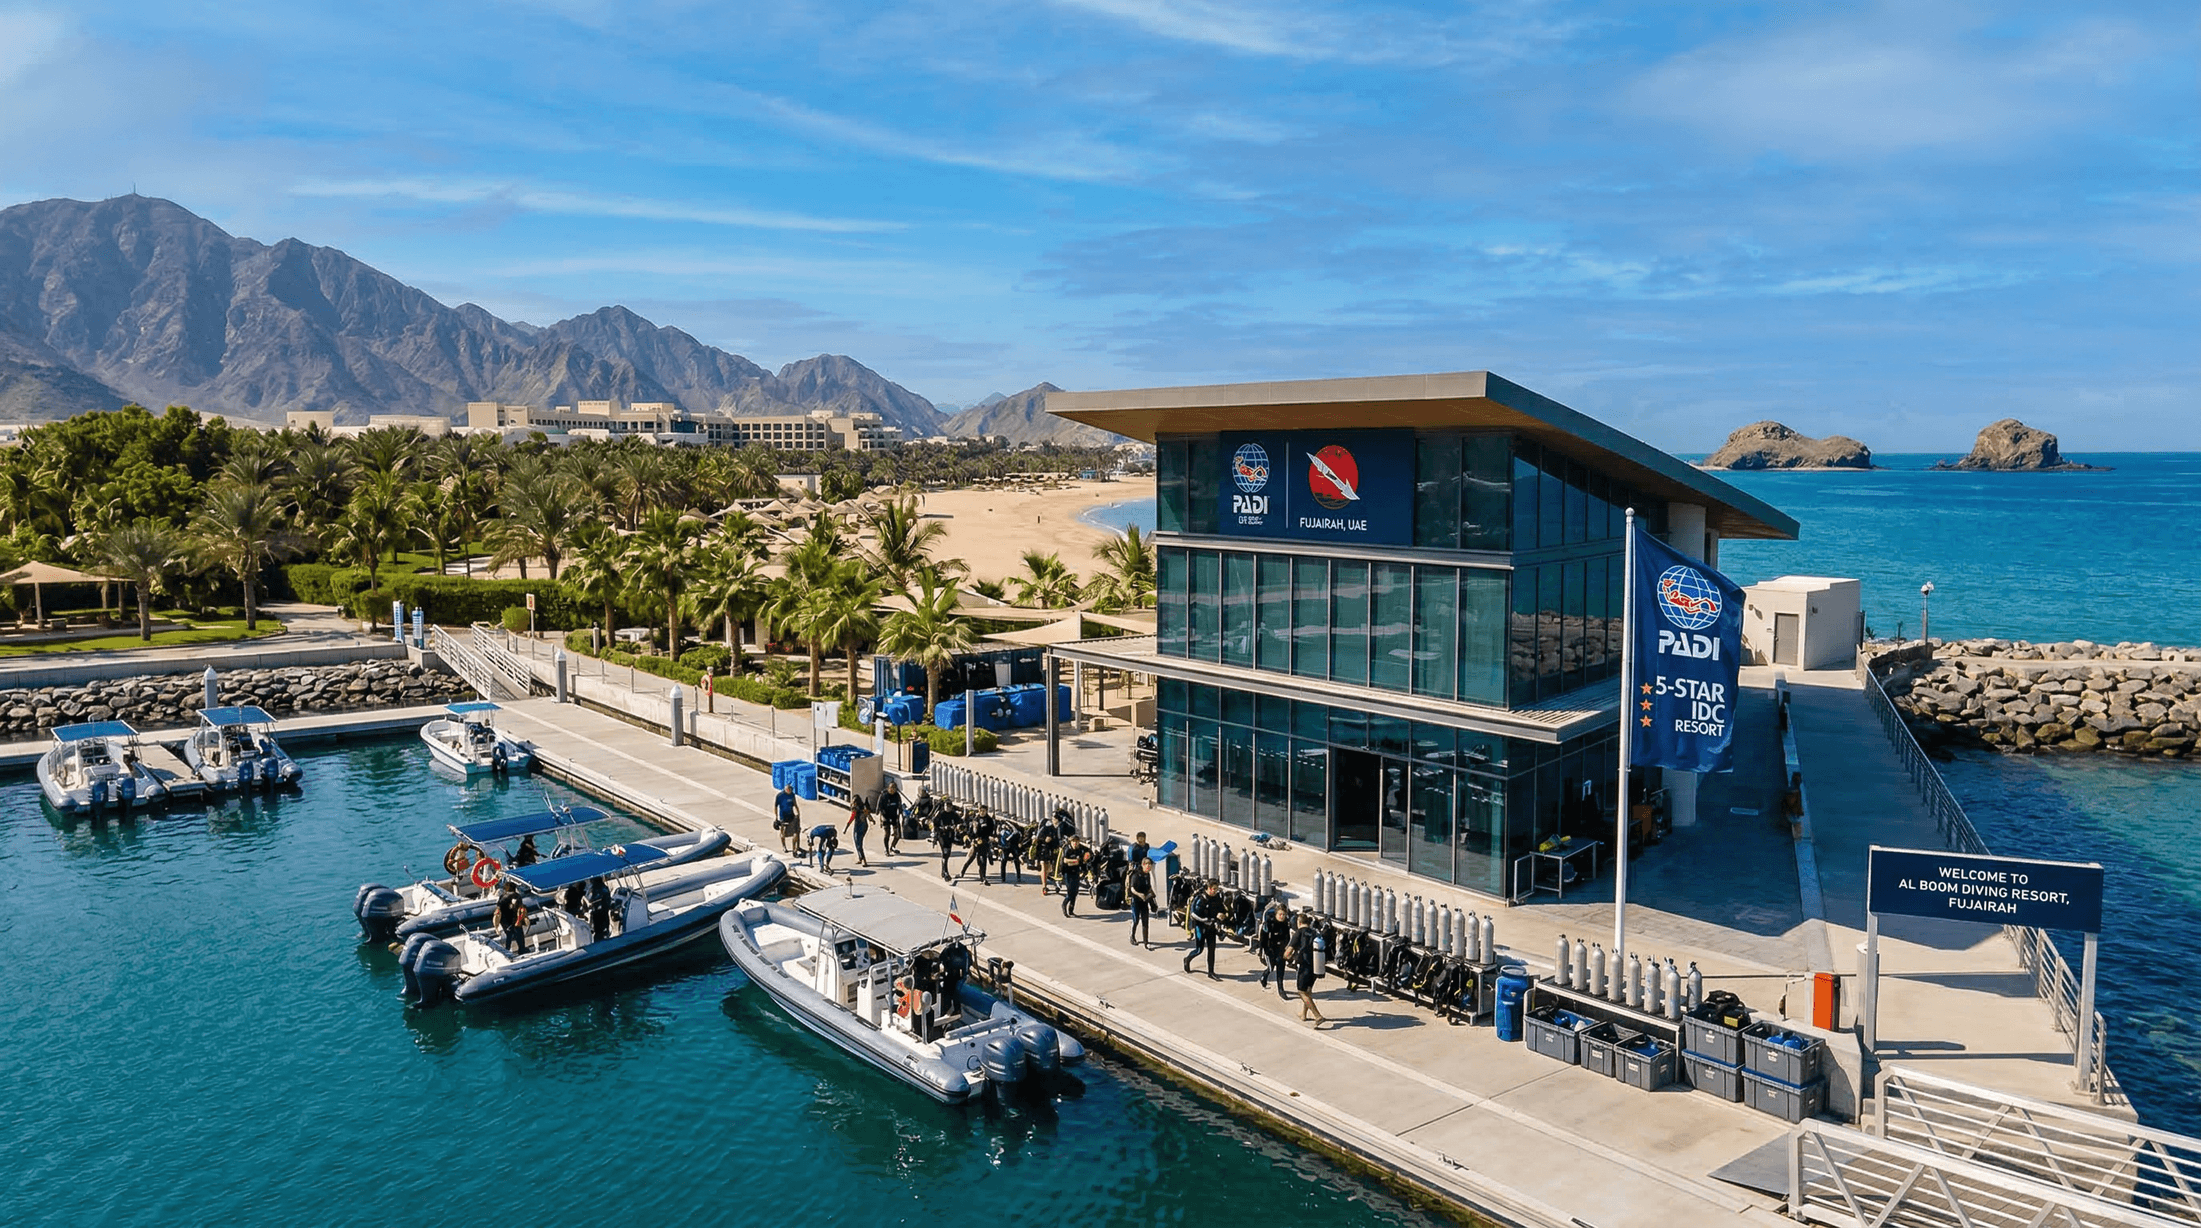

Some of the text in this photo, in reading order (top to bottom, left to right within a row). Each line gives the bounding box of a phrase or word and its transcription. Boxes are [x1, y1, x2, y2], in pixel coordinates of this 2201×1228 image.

[1233, 495, 1268, 514] PADI
[1300, 517, 1367, 531] FUJAIRAH, UAE
[1659, 630, 1720, 660] PADI
[1655, 675, 1725, 703] 5-STAR
[1692, 701, 1725, 723] IDC
[1675, 719, 1725, 737] RESORT
[1939, 866, 2029, 885] WELCOME TO
[1898, 878, 2070, 905] AL BOOM DIVING RESORT,
[1948, 897, 2017, 914] FUJAIRAH
